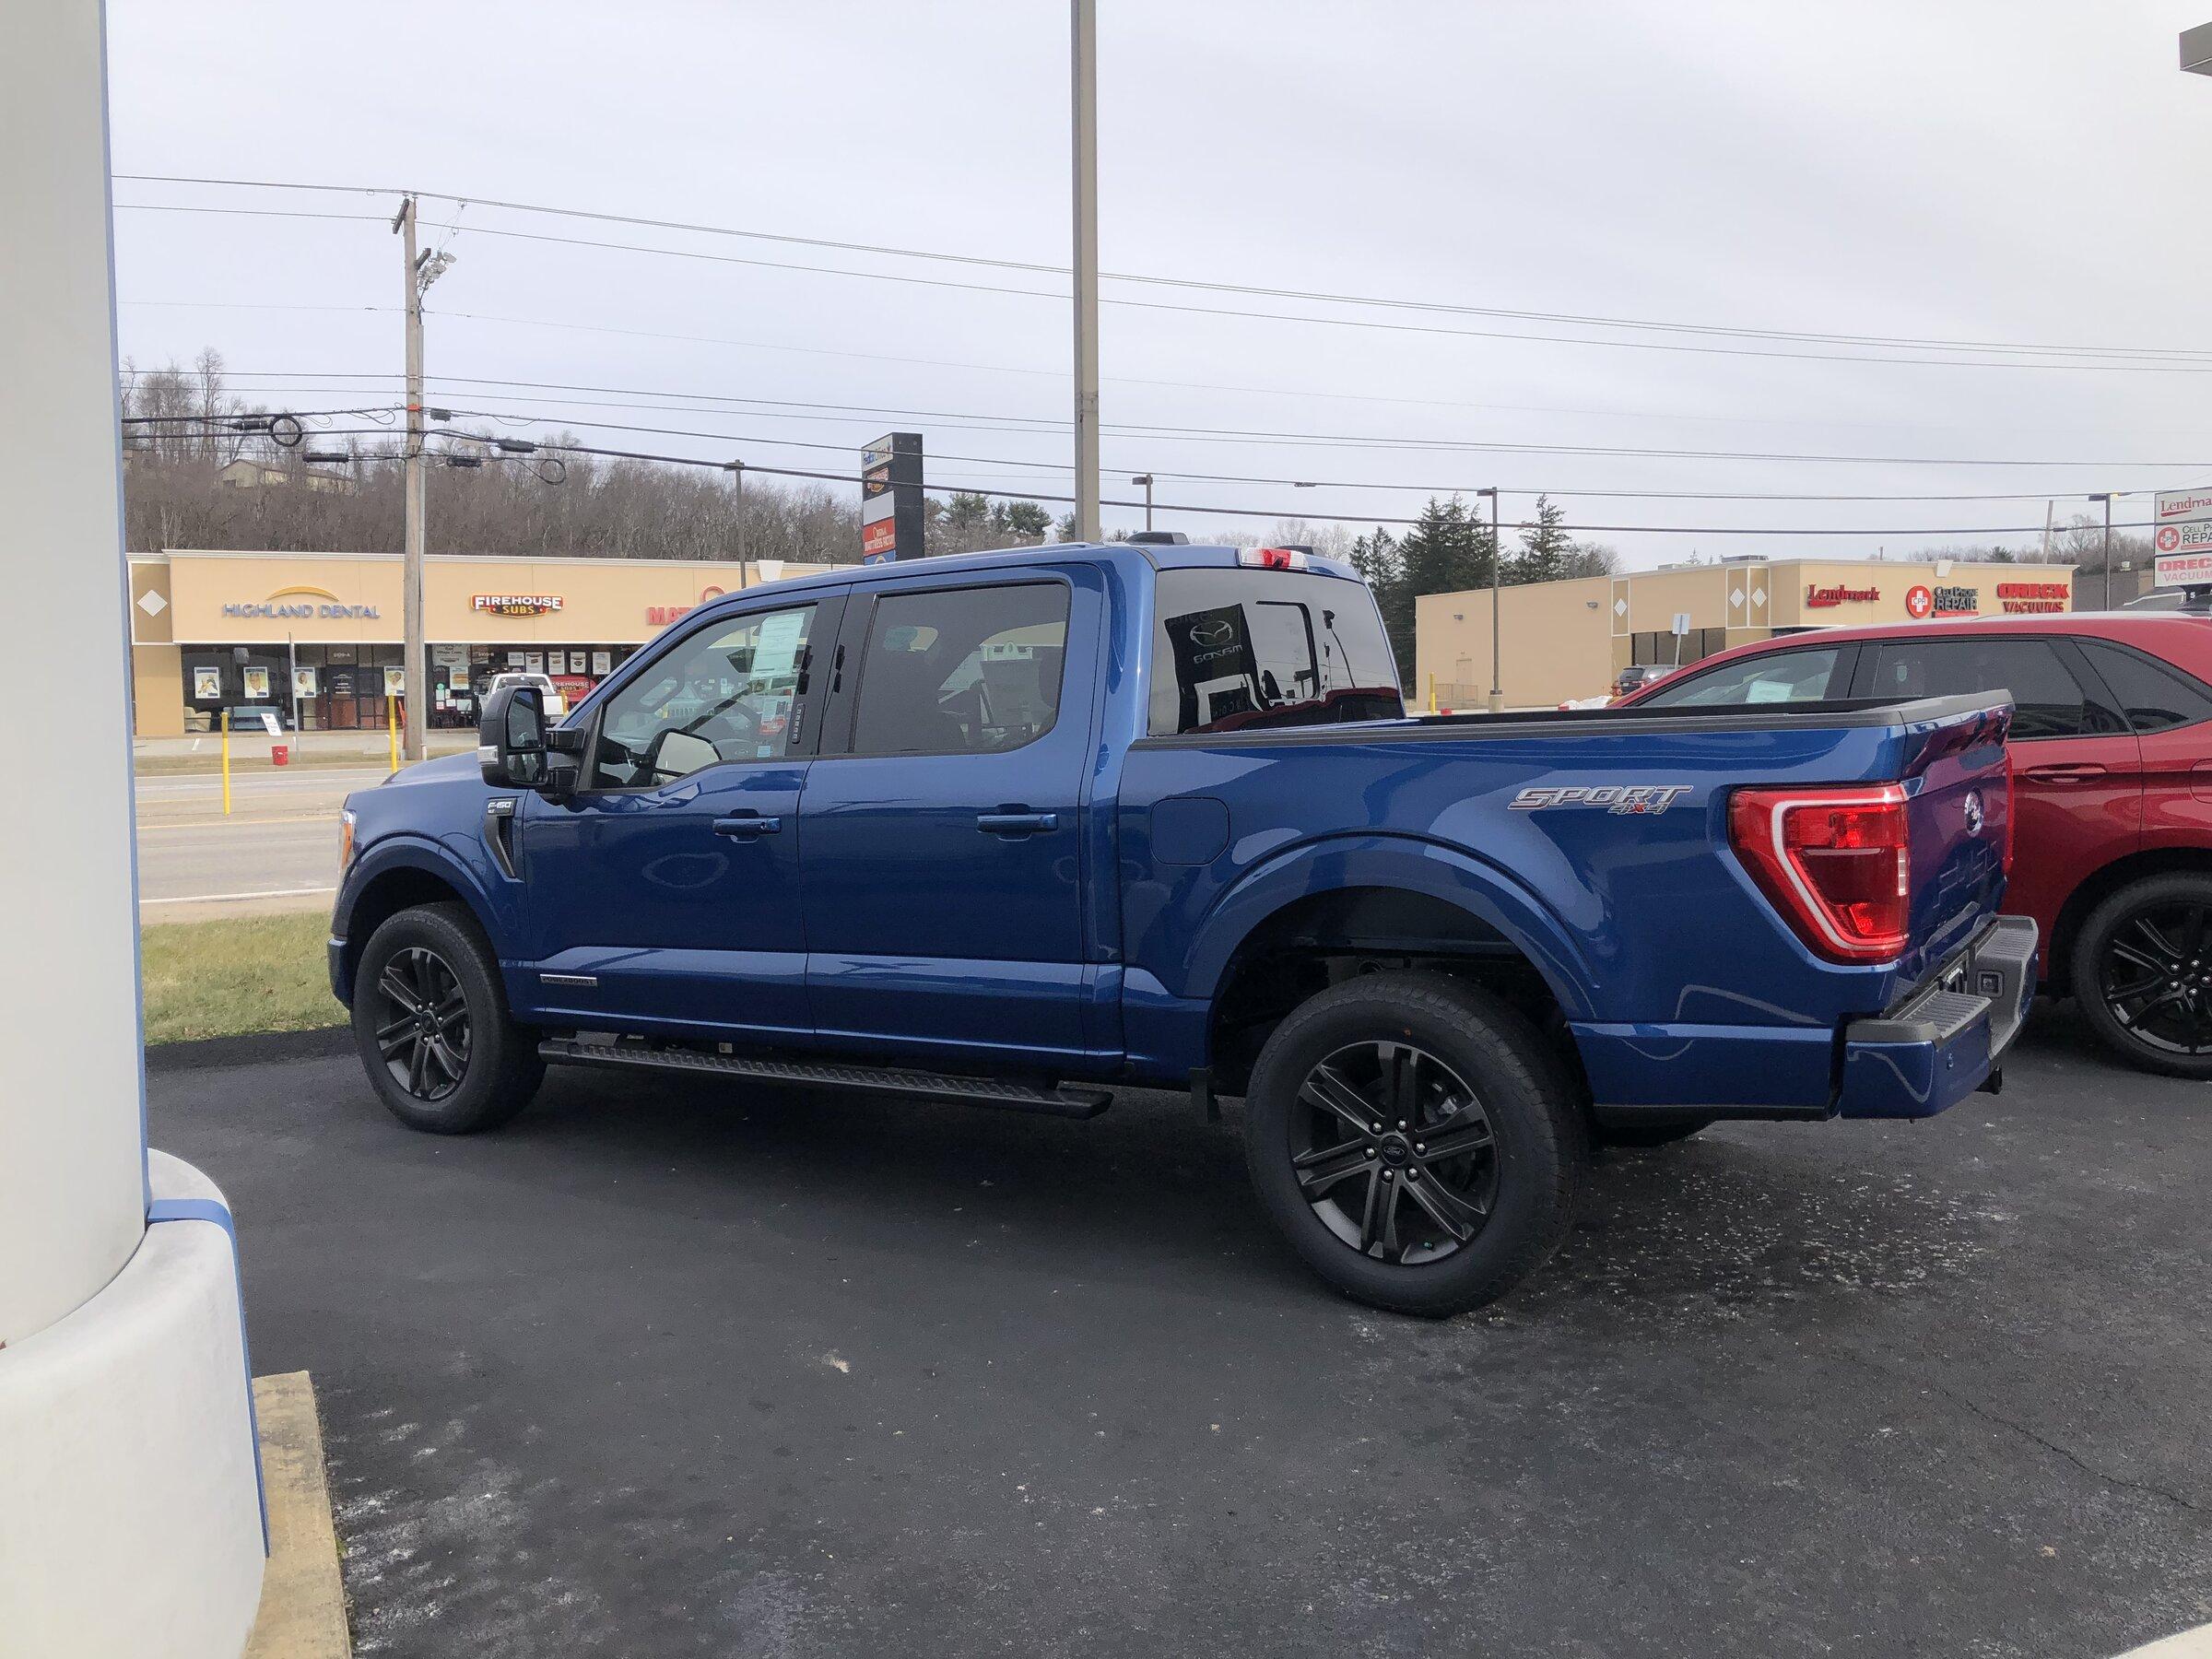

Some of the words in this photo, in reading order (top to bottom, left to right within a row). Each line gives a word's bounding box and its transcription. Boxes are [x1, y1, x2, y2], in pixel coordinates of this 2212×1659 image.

[1808, 584, 1881, 601] Lendmark
[1998, 582, 2070, 599] ORECK
[475, 596, 562, 610] FIREHOUSE
[502, 606, 535, 614] SUBS
[1935, 597, 1978, 610] REPAIR
[223, 604, 313, 618] HIGHLAND
[318, 605, 380, 619] DENTAL
[1507, 785, 1694, 810] SPORT
[488, 801, 512, 809] F-150
